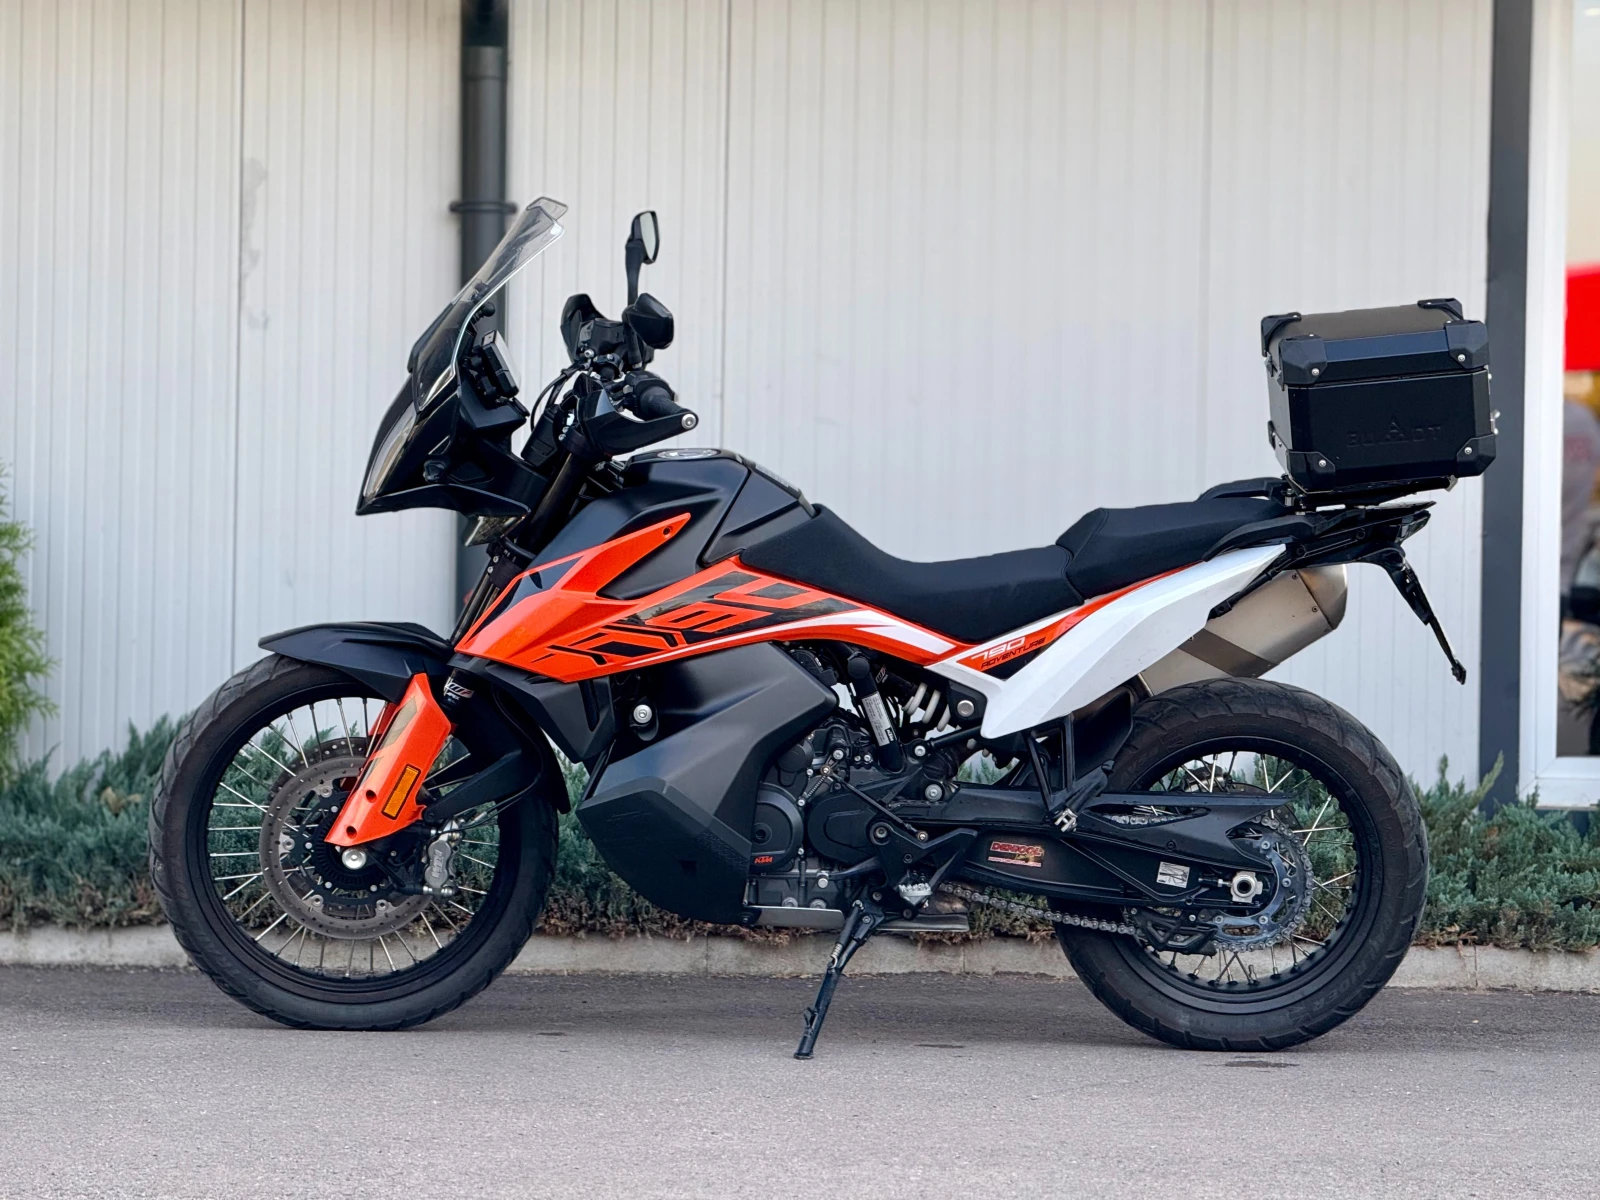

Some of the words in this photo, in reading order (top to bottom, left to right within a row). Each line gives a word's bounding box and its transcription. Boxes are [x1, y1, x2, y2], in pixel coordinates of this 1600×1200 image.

[971, 636, 1026, 660] 790
[980, 637, 1047, 669] ADVENTURE
[754, 855, 773, 864] KTM
